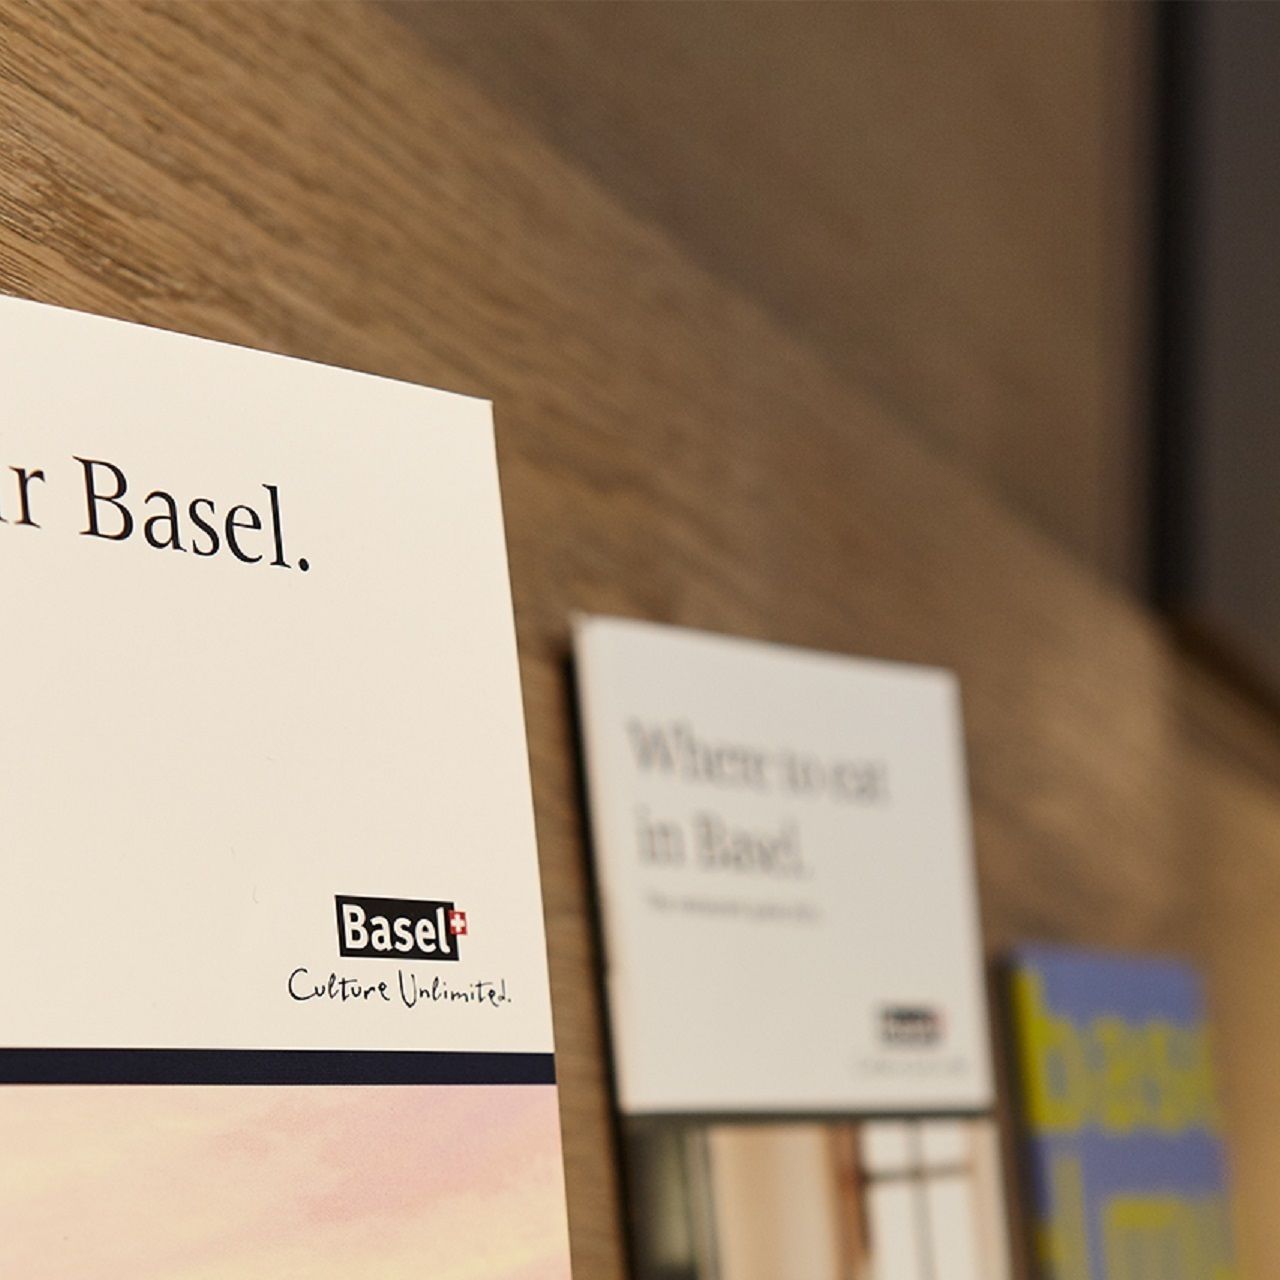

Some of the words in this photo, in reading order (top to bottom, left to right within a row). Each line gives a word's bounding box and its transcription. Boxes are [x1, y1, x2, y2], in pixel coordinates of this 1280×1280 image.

[72, 455, 310, 572] Basel.
[341, 903, 452, 955] Basel
[288, 967, 391, 1003] Culture
[398, 968, 512, 1009] Unlimited.
